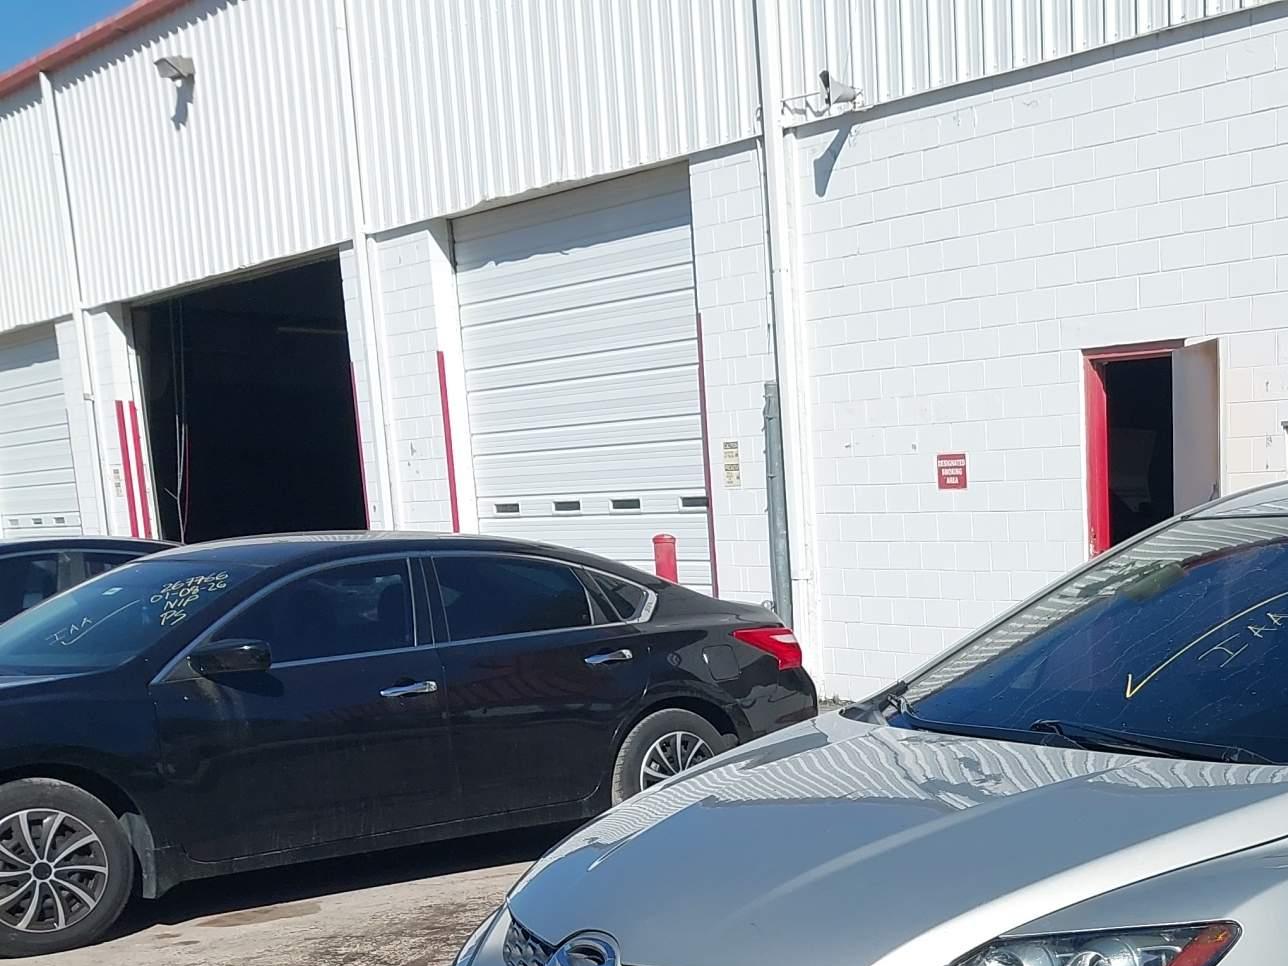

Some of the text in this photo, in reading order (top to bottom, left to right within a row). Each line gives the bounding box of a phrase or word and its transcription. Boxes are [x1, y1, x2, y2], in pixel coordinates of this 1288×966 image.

[946, 476, 959, 484] AREA
[164, 594, 199, 611] NIP
[160, 609, 186, 626] PS
